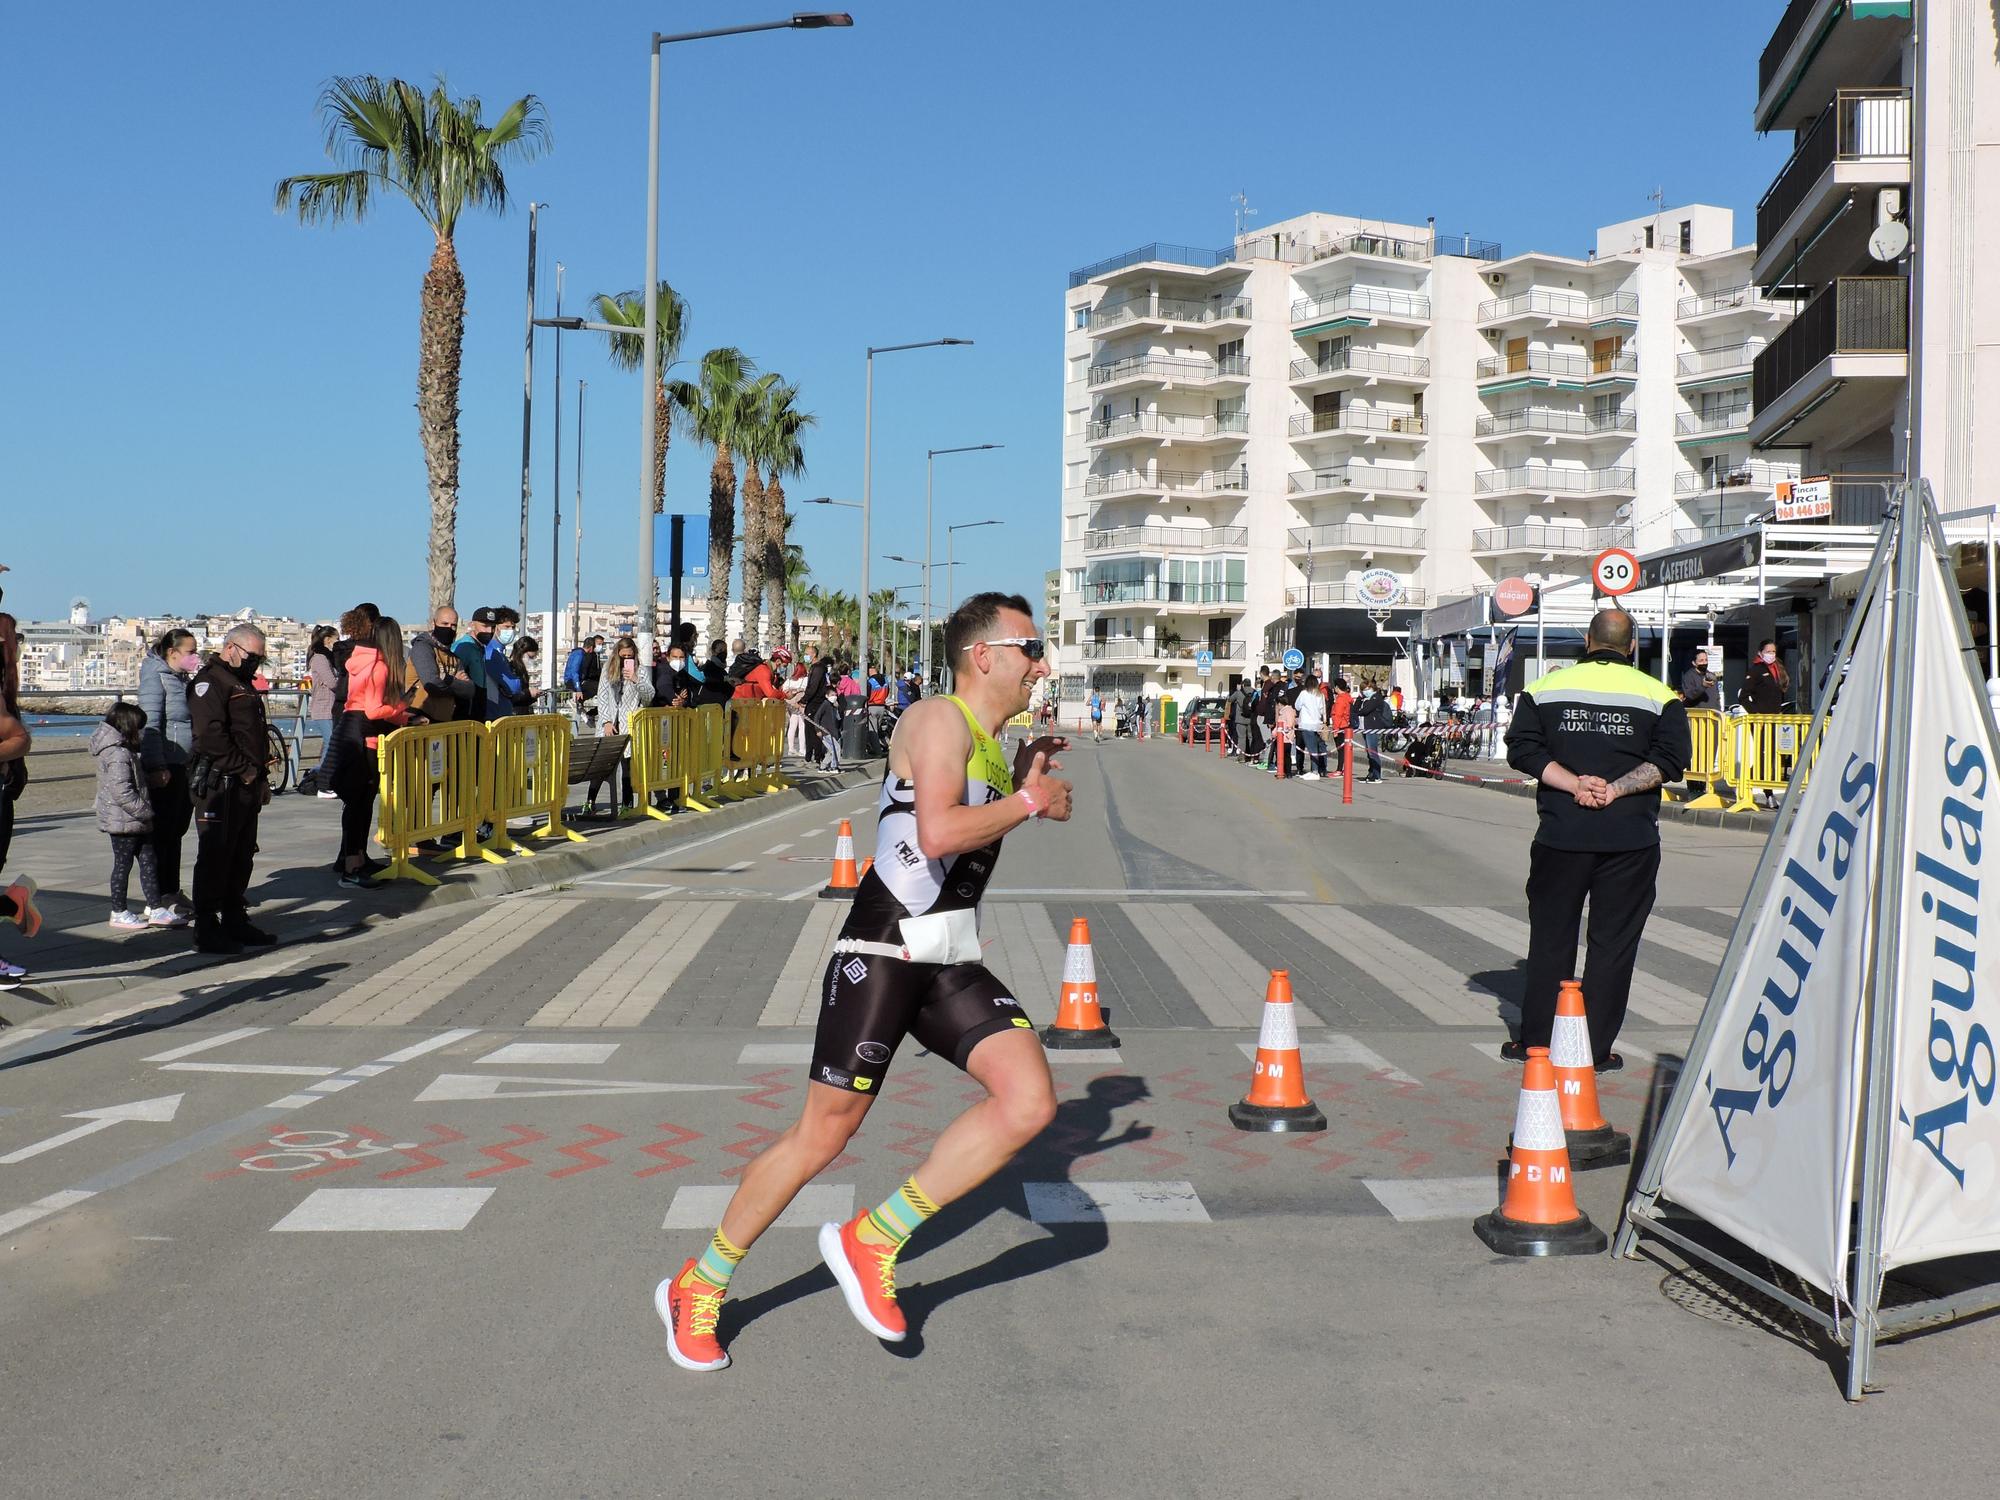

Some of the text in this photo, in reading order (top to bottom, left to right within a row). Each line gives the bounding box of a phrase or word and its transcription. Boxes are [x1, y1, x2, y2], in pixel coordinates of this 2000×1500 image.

[1778, 502, 1830, 519] 968 446 839
[1603, 565, 1629, 579] 30
[1636, 569, 1648, 588] AR
[1562, 709, 1630, 724] SERVICIOS
[1558, 721, 1634, 736] AUXILIARES
[1706, 752, 1876, 1169] Águilas
[1900, 735, 1996, 1191] Águilas
